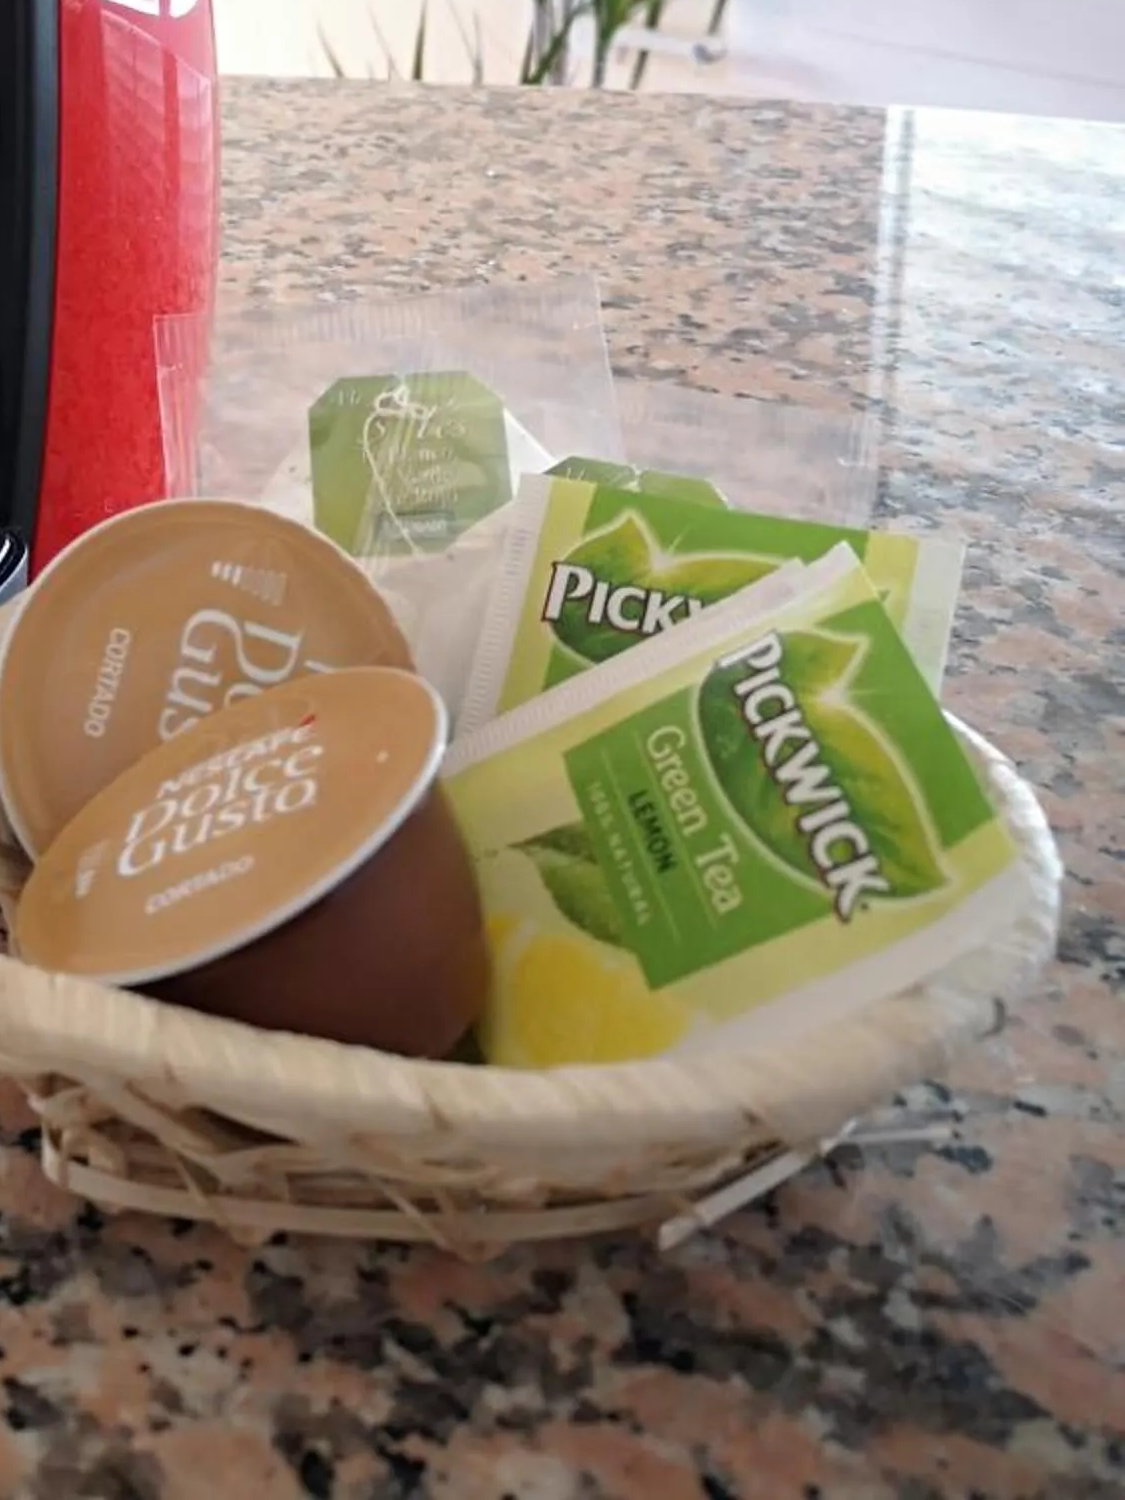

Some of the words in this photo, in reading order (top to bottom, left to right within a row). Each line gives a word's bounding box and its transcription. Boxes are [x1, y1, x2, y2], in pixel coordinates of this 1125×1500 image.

[541, 561, 704, 636] PICK
[83, 627, 132, 739] CORTADO
[158, 609, 227, 741] Gus
[117, 779, 318, 877] Gusto
[125, 745, 324, 843] Dolce
[646, 725, 708, 837] Green
[696, 832, 742, 914] Tea
[715, 629, 892, 925] PICKWICK
[629, 789, 678, 873] LEMON
